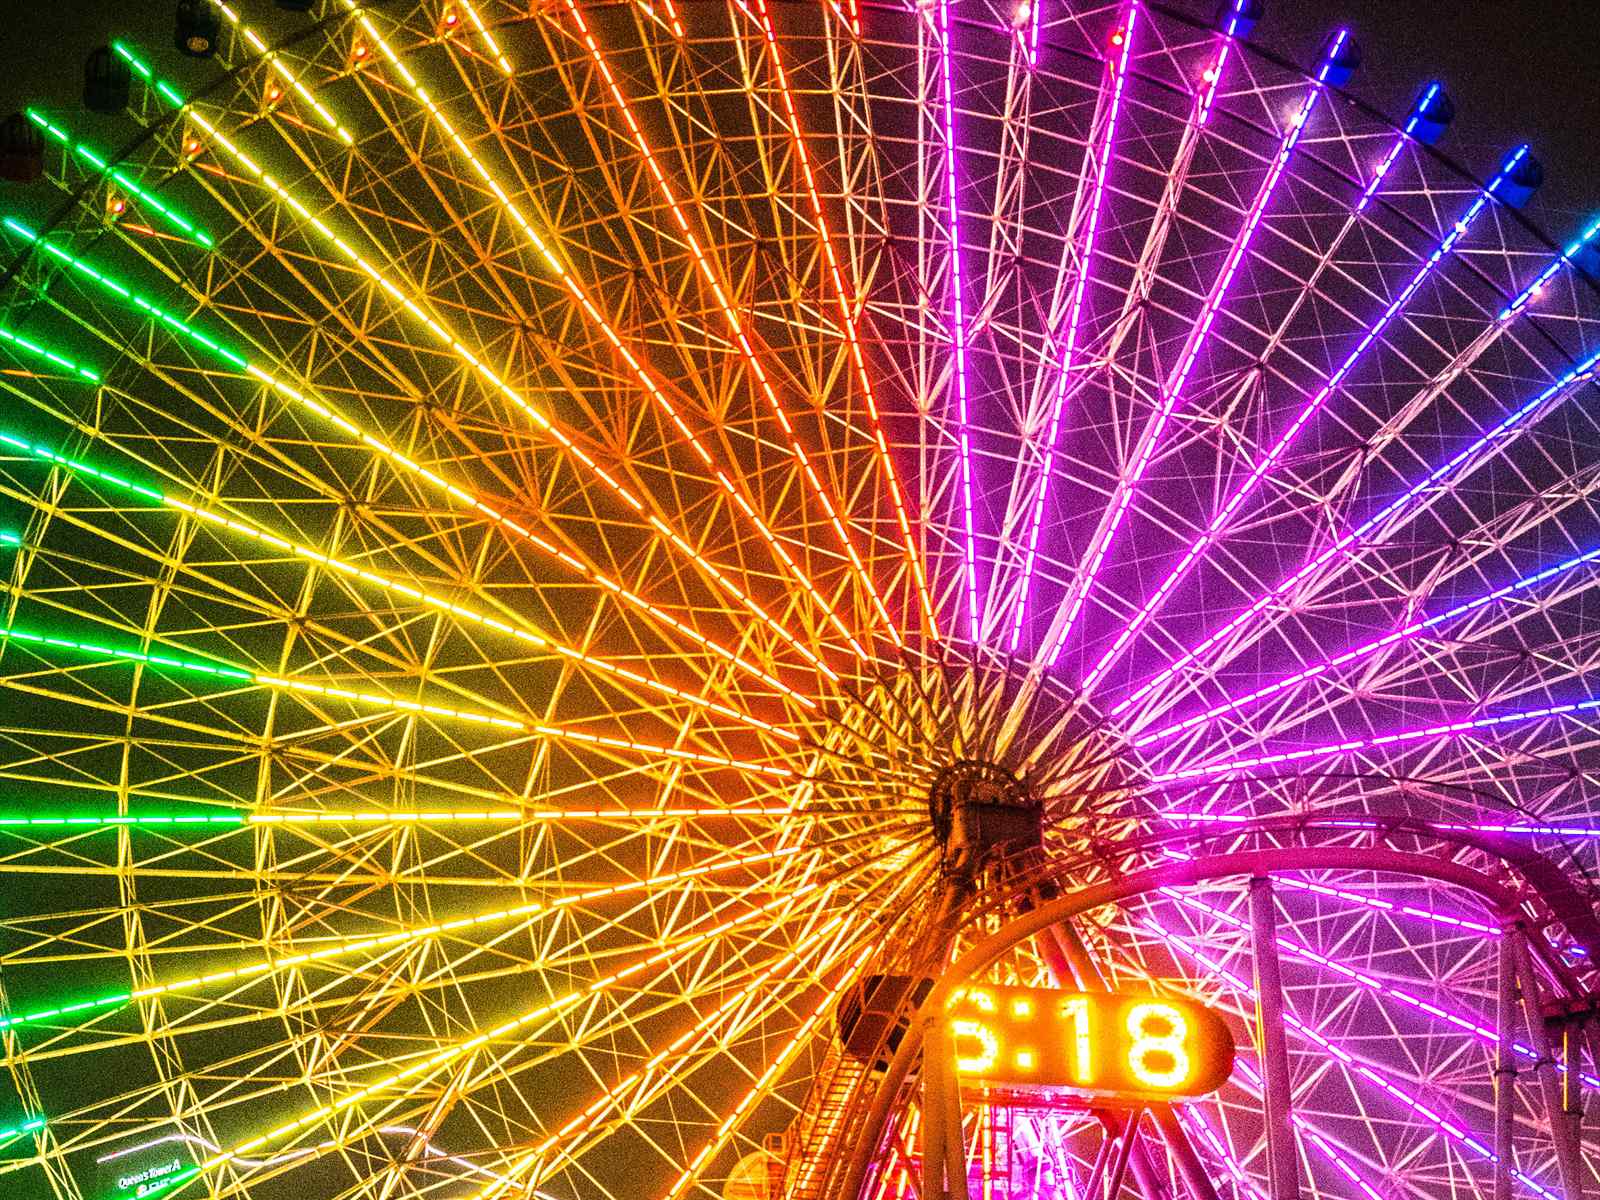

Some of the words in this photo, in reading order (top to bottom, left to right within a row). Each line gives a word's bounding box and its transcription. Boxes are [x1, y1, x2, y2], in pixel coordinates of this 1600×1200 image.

[119, 1172, 149, 1188] Queen's
[149, 1165, 172, 1178] Tower
[172, 1159, 181, 1170] A
